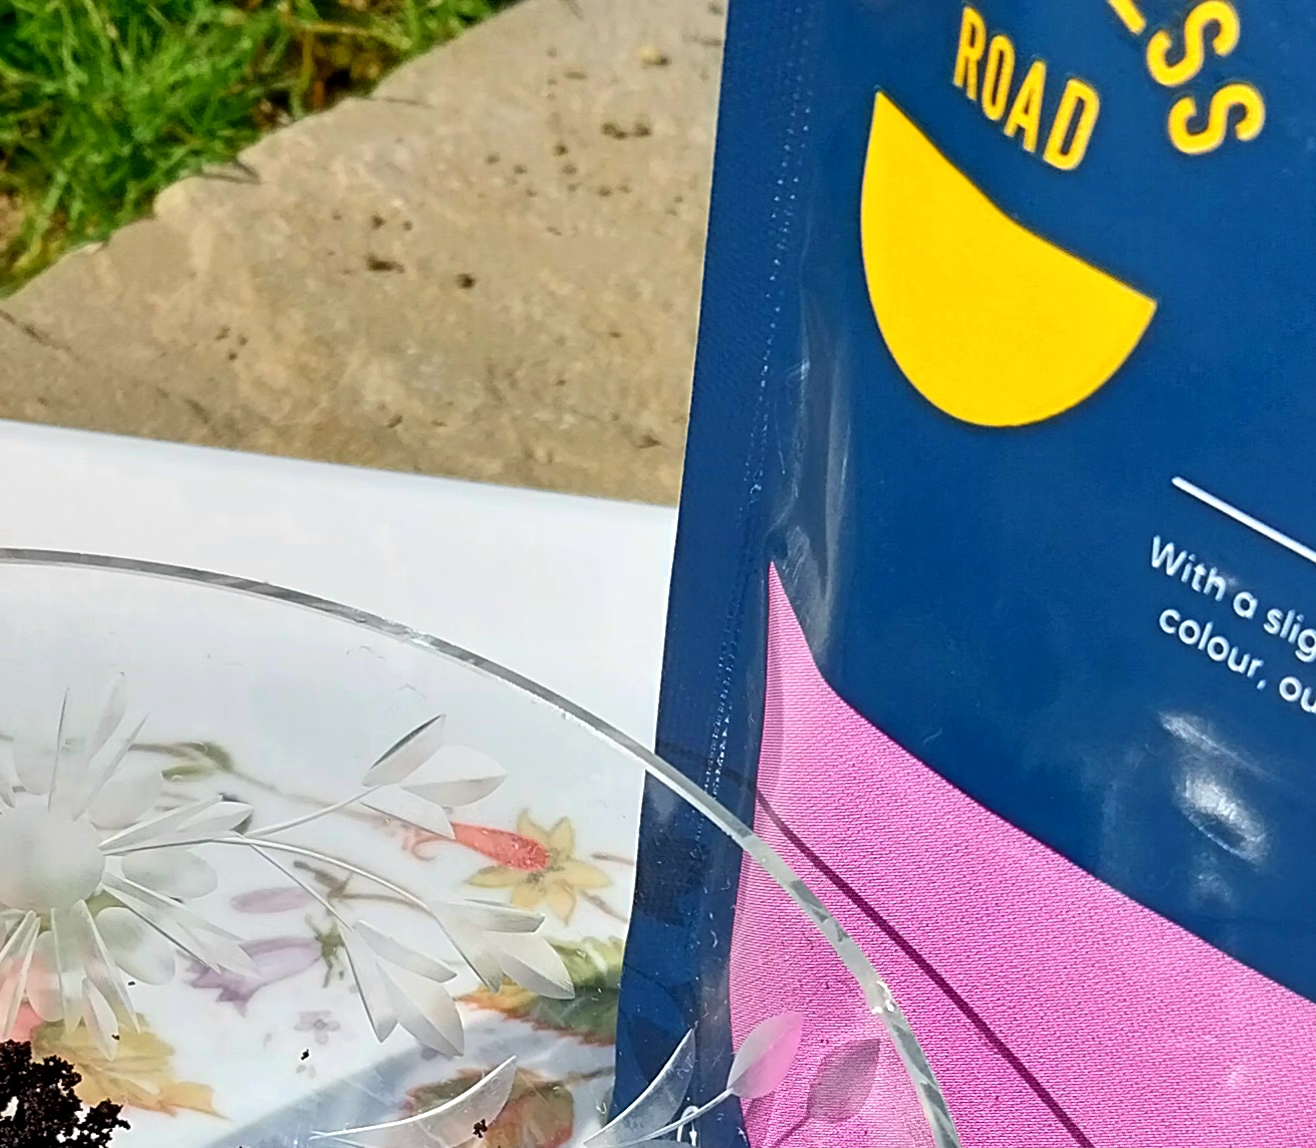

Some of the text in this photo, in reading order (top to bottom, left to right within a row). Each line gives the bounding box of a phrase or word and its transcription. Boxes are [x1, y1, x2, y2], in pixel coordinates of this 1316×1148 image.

[953, 5, 1100, 170] ROAD
[1108, 0, 1266, 154] SS
[1150, 536, 1226, 602] With
[1233, 590, 1259, 619] a
[1159, 608, 1268, 689] colour,
